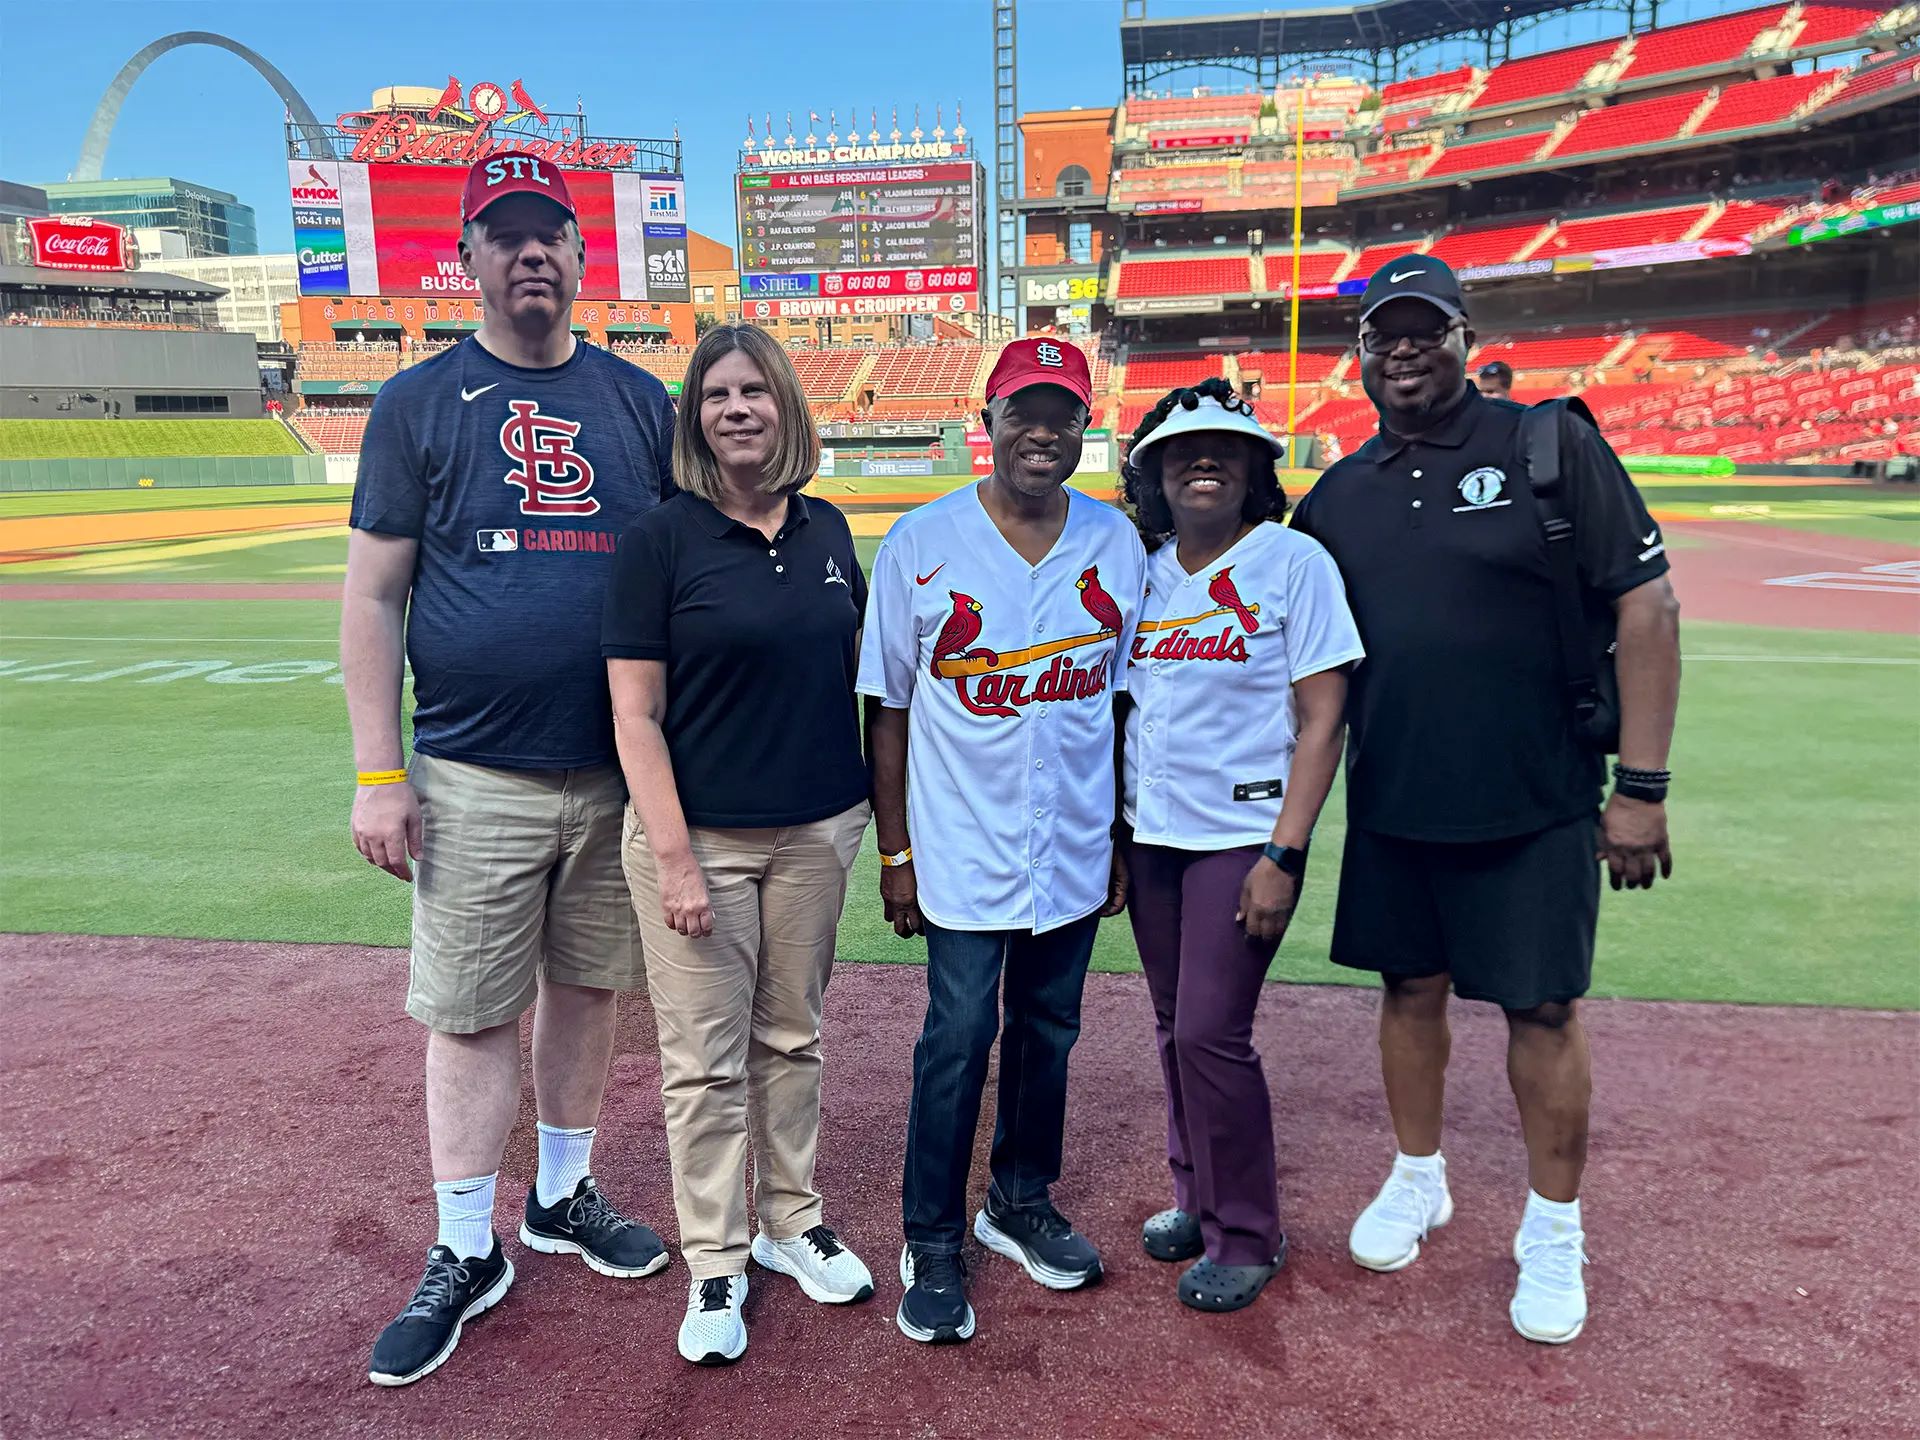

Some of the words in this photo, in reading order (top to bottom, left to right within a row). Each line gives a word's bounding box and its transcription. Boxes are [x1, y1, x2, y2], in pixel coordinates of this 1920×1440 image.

[336, 112, 638, 166] Budweiser
[759, 147, 832, 167] WORLD
[834, 142, 953, 163] CHAMPIONS
[485, 156, 550, 187] STL
[788, 176, 800, 185] AL
[801, 175, 813, 184] ON
[814, 174, 835, 184] BASE
[836, 171, 887, 183] PERCENTAGE
[888, 169, 924, 181] LEADERS
[292, 187, 339, 200] KMOX
[790, 194, 809, 202] JUDGE
[295, 215, 322, 225] 104.1
[325, 216, 342, 225] FM
[769, 226, 792, 235] RAFAEL
[793, 225, 816, 234] DEVERS
[45, 233, 111, 256] Coca-Cola
[300, 249, 346, 266] Cutter
[649, 273, 686, 282] TODAY
[759, 276, 804, 292] STIFEL
[847, 277, 861, 290] GO
[861, 276, 875, 289] GO
[876, 275, 891, 289] GO
[927, 273, 942, 287] GO
[943, 272, 957, 286] GO
[957, 271, 972, 286] GO
[780, 300, 837, 316] BROWN
[840, 302, 851, 314] &
[854, 296, 938, 314] CROUPPEN
[352, 305, 359, 320] 1
[367, 306, 377, 320] 2
[385, 306, 396, 320] 6
[404, 306, 415, 320] 9
[424, 306, 439, 320] 10
[448, 306, 465, 321] 14
[581, 308, 599, 323] 42
[608, 309, 626, 324] 45
[632, 310, 650, 324] 85
[523, 528, 623, 554] CARDINAL
[1131, 625, 1251, 664] rdinals
